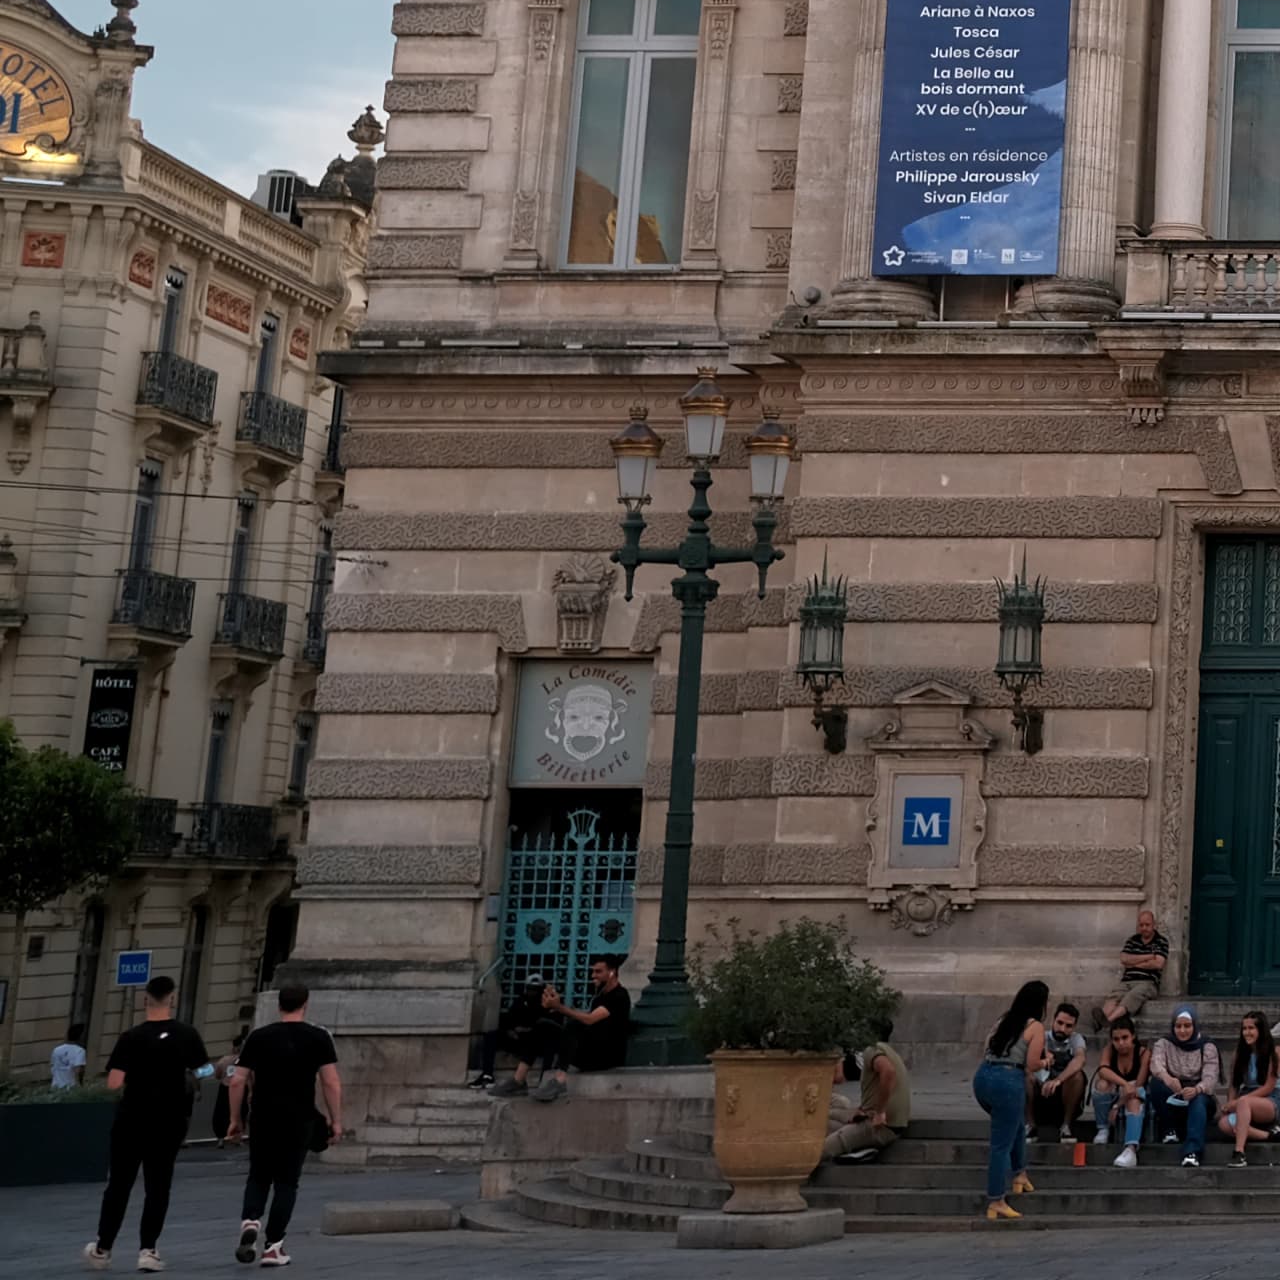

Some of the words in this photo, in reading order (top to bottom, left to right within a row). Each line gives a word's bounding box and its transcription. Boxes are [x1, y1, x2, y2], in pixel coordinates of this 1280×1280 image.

[920, 5, 971, 18] Ariane
[974, 5, 985, 18] à
[988, 5, 1036, 18] Naxos
[953, 26, 1000, 38] Tosca
[930, 46, 971, 60] Jules
[974, 45, 1021, 59] César
[933, 67, 951, 80] La
[954, 66, 991, 80] Belle
[994, 69, 1014, 79] au
[920, 82, 953, 96] bois
[956, 82, 1025, 95] dormant
[915, 104, 938, 116] XV
[940, 103, 961, 116] de
[963, 102, 1028, 119] c(h)œur
[889, 150, 947, 163] Artistes
[949, 153, 970, 163] en
[973, 149, 1049, 163] résidence
[896, 170, 958, 186] Philippe
[960, 170, 1040, 186] Jaroussky
[923, 191, 967, 204] Sivan
[969, 190, 1009, 204] Eldar
[95, 676, 134, 689] HÔTEL
[541, 677, 563, 695] La
[568, 664, 637, 697] Comédie
[90, 744, 120, 757] CAFÉ
[536, 749, 631, 782] Billetterie
[911, 812, 942, 838] M
[120, 962, 147, 974] TAXIS
